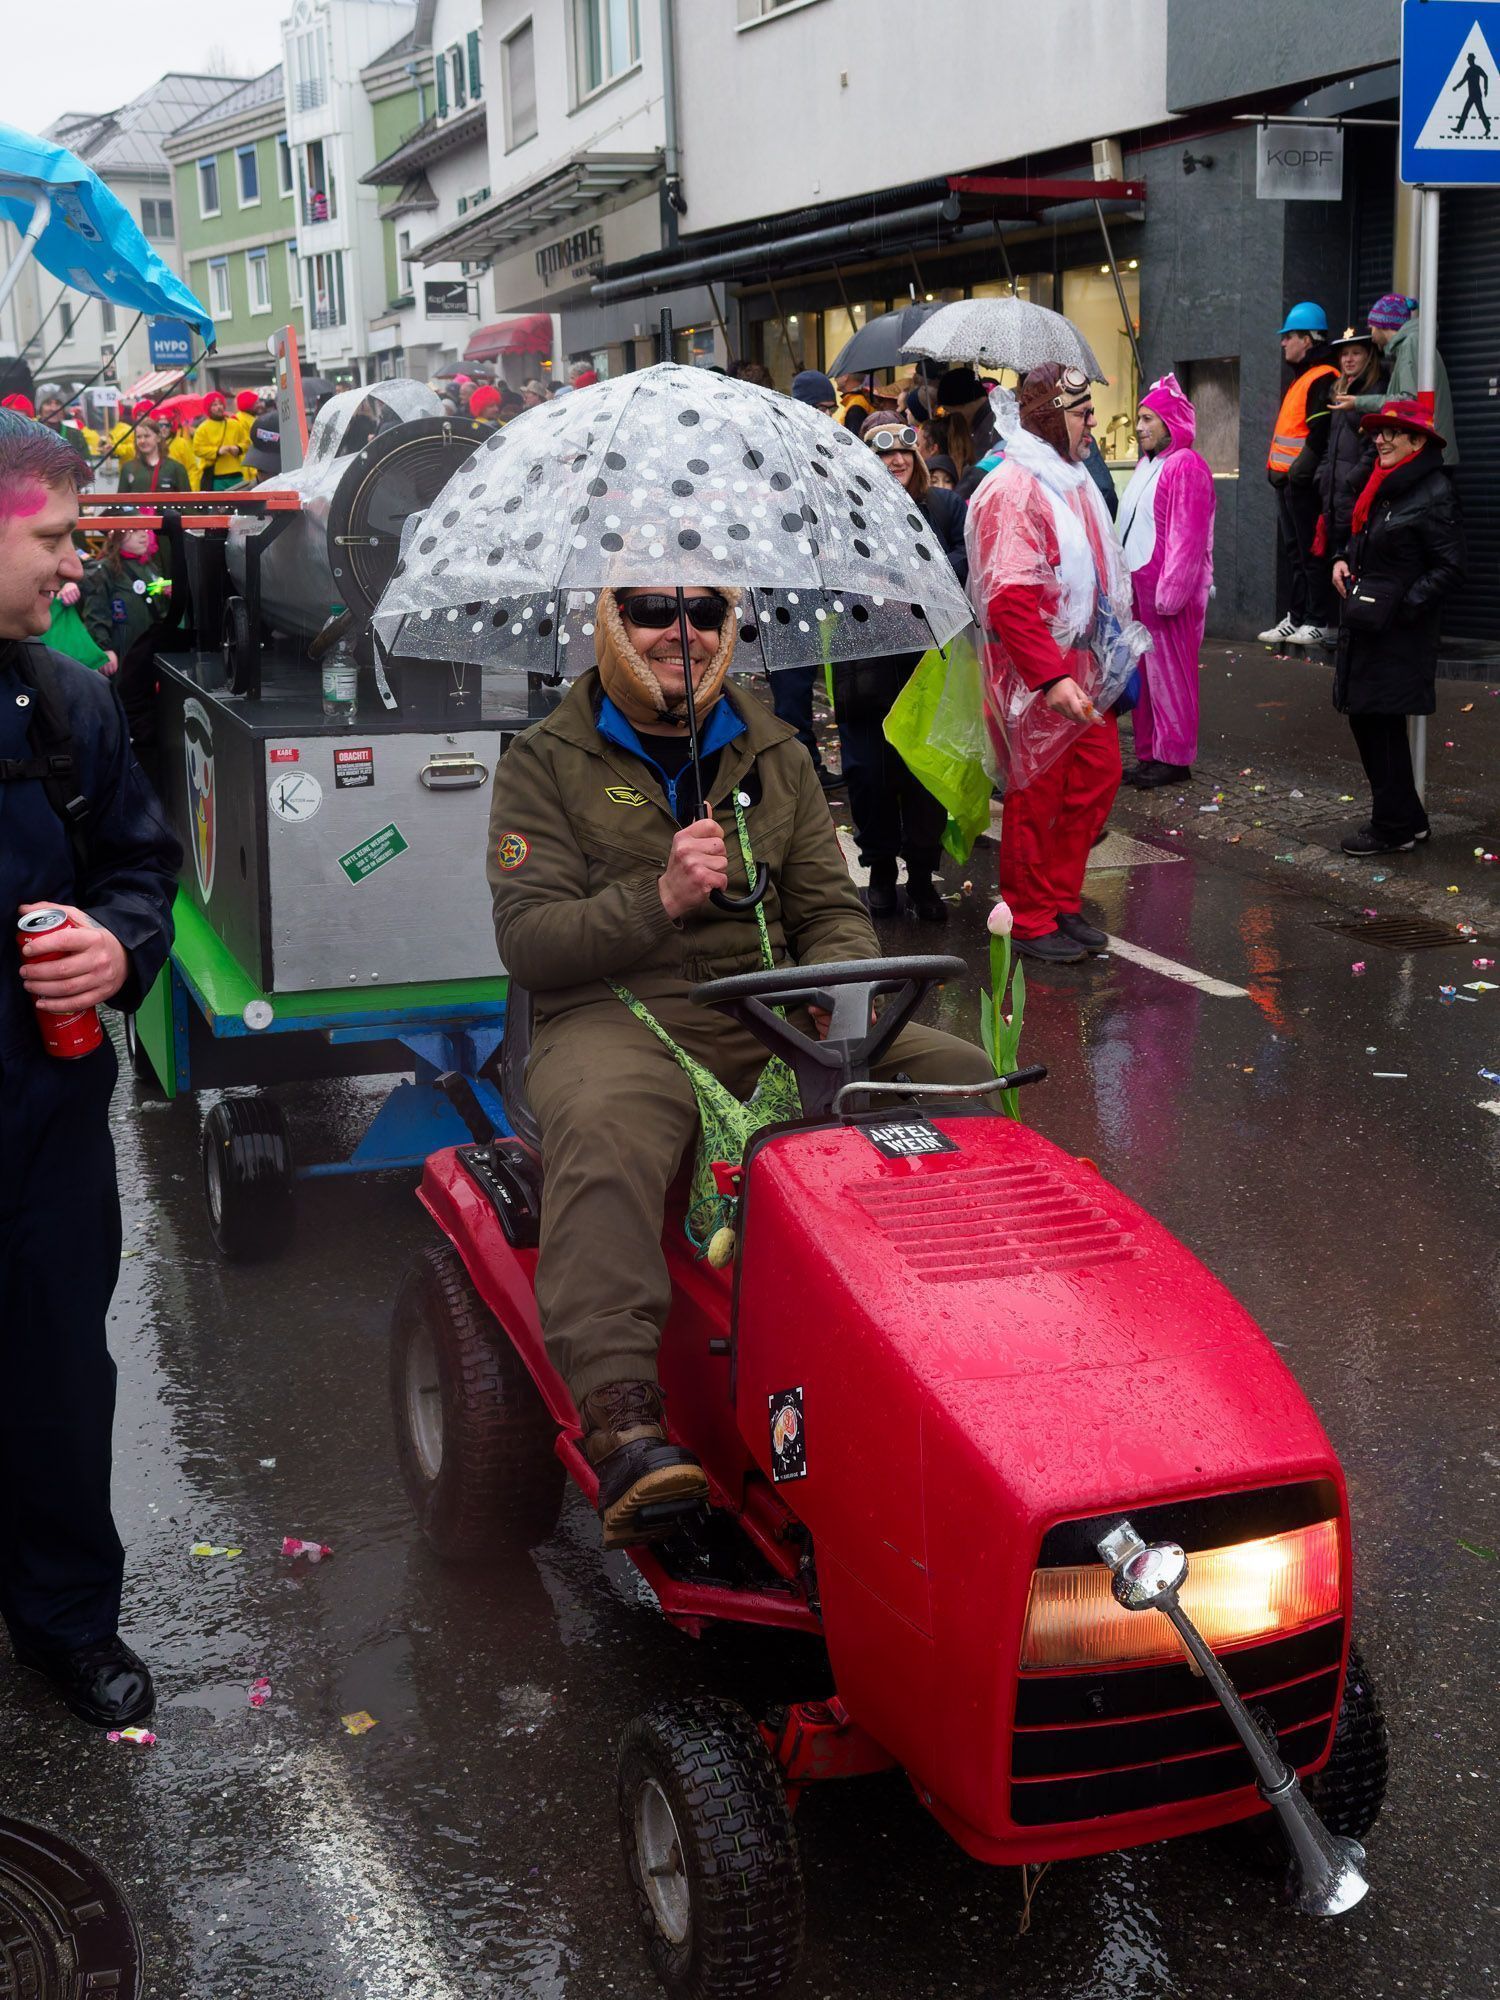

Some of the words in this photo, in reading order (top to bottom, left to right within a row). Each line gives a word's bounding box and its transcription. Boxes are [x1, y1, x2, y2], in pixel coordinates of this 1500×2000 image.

[1267, 149, 1333, 167] KOPF
[154, 340, 188, 352] HYPO
[338, 751, 369, 762] OBACHT!
[343, 854, 358, 867] BITTE
[356, 844, 372, 858] KEINE
[869, 1125, 938, 1142] APFEL
[883, 1136, 943, 1152] WEIN
